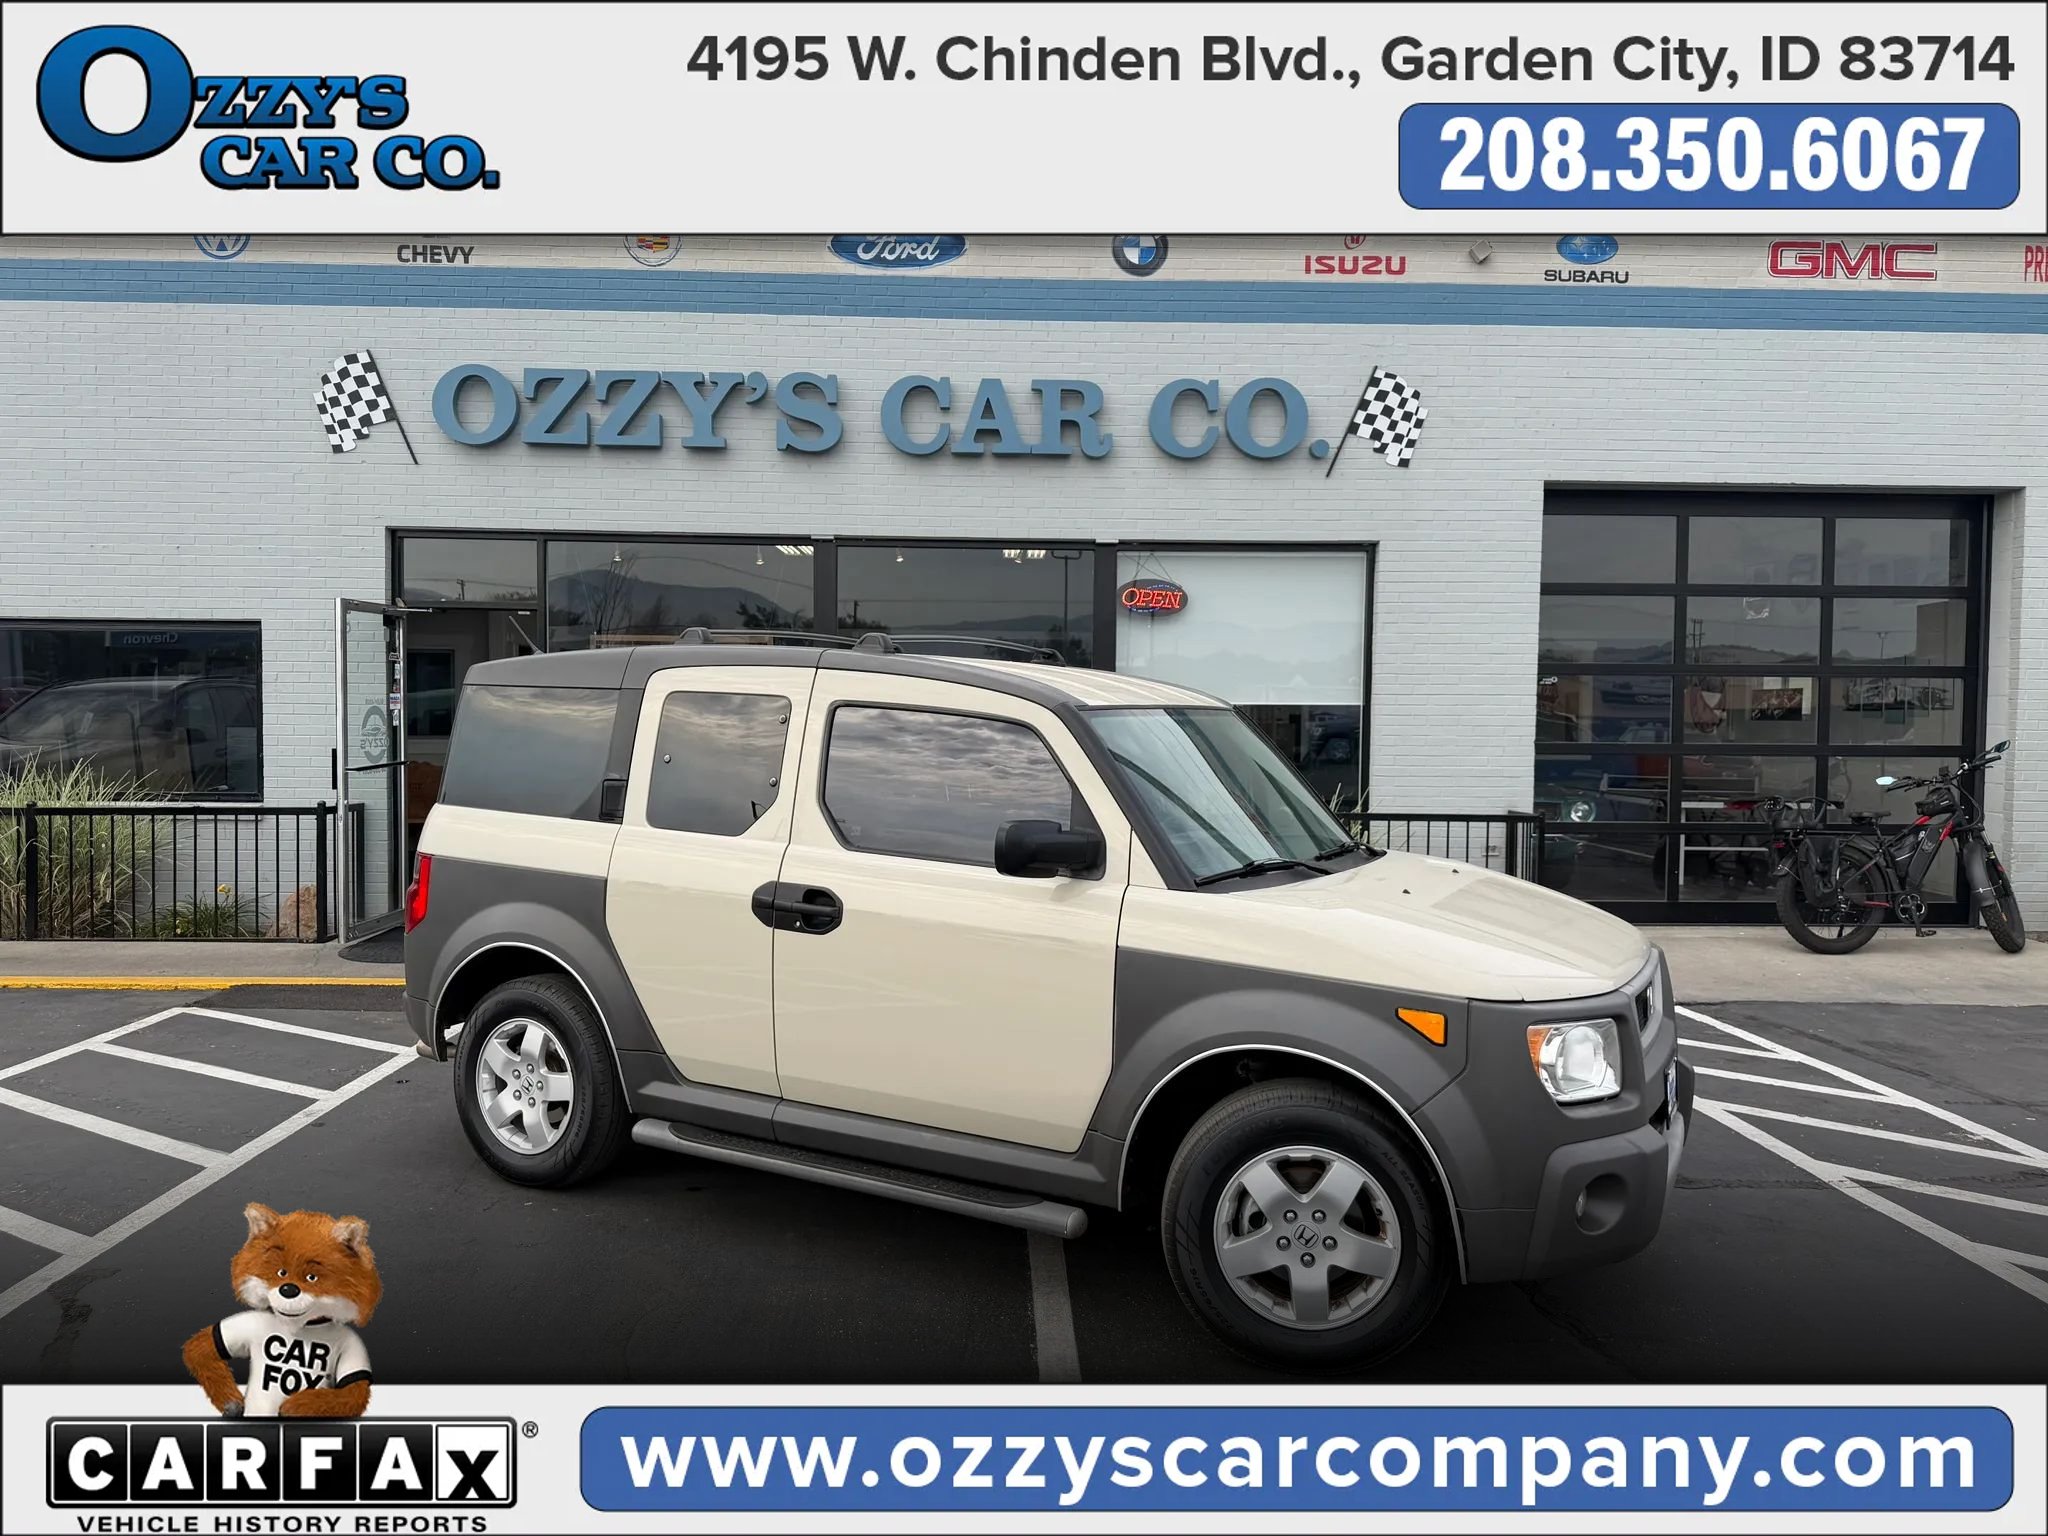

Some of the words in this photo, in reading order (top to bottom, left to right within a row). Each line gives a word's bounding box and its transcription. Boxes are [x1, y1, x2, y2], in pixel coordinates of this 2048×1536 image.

[397, 244, 475, 265] CHEVY
[856, 235, 941, 261] Ford
[1304, 255, 1406, 275] ISUZU
[1767, 239, 1938, 280] GMC
[1543, 268, 1630, 284] SUBARU
[431, 363, 844, 455] OZZY'S
[880, 374, 1114, 459] CAR
[1148, 376, 1331, 460] CO.
[1122, 588, 1183, 609] OPEN
